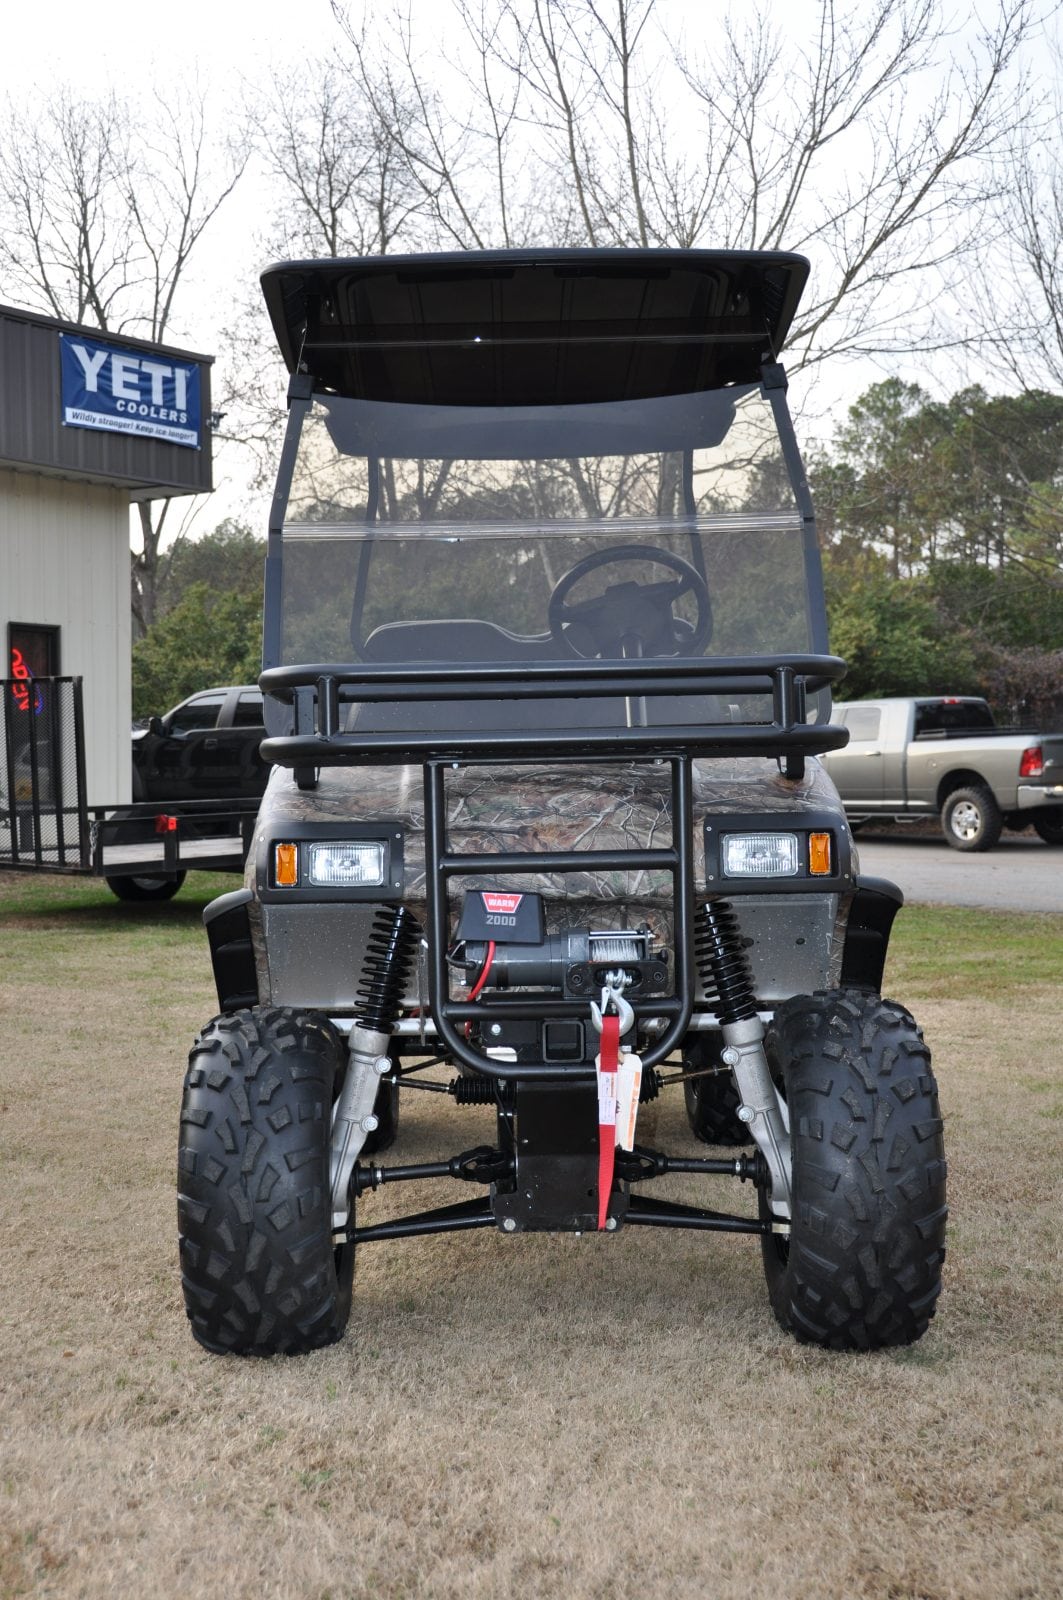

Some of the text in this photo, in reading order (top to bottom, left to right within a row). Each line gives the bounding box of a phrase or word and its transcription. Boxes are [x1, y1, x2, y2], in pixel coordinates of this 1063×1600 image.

[71, 344, 187, 411] YETI
[71, 411, 97, 424] Wildly
[116, 399, 188, 424] COOLERS
[488, 898, 515, 908] WARN
[486, 914, 517, 927] 2000
